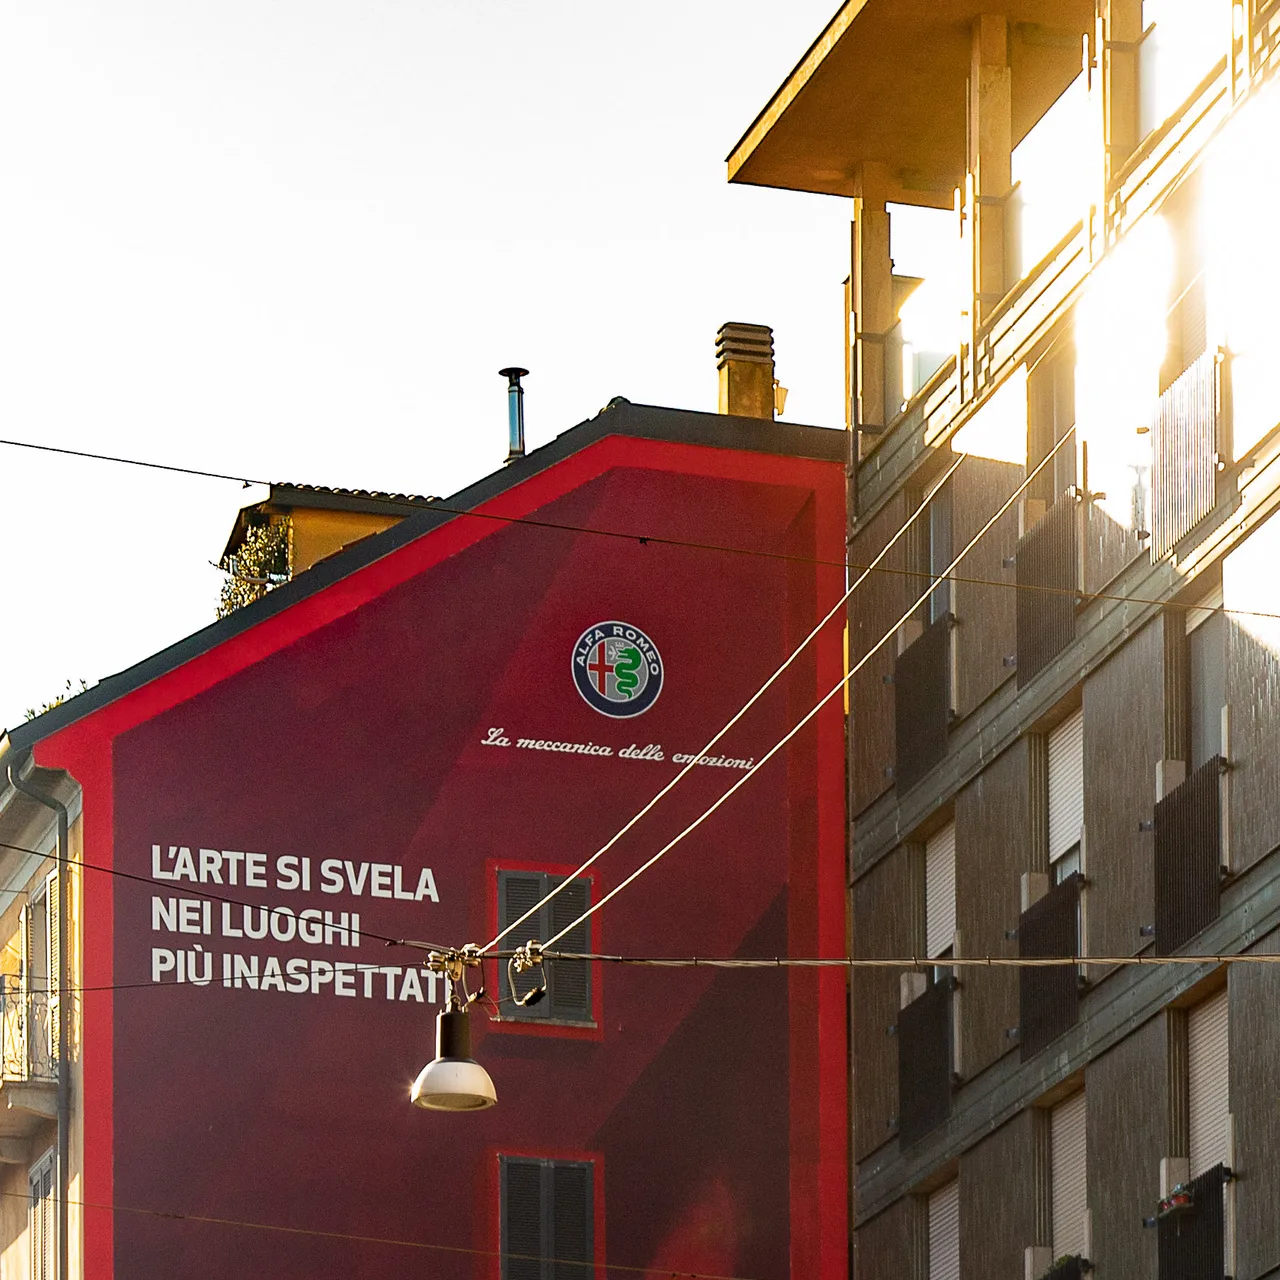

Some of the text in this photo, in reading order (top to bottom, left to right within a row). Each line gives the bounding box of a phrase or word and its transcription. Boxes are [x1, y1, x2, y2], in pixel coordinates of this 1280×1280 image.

[576, 625, 659, 676] ALFA ROMEO
[481, 727, 754, 770] La meccanica delle emozioni
[152, 845, 440, 903] L'ARTE SI SVELA
[152, 896, 360, 947] NEI LUOGHI
[152, 944, 213, 986] PIÙ
